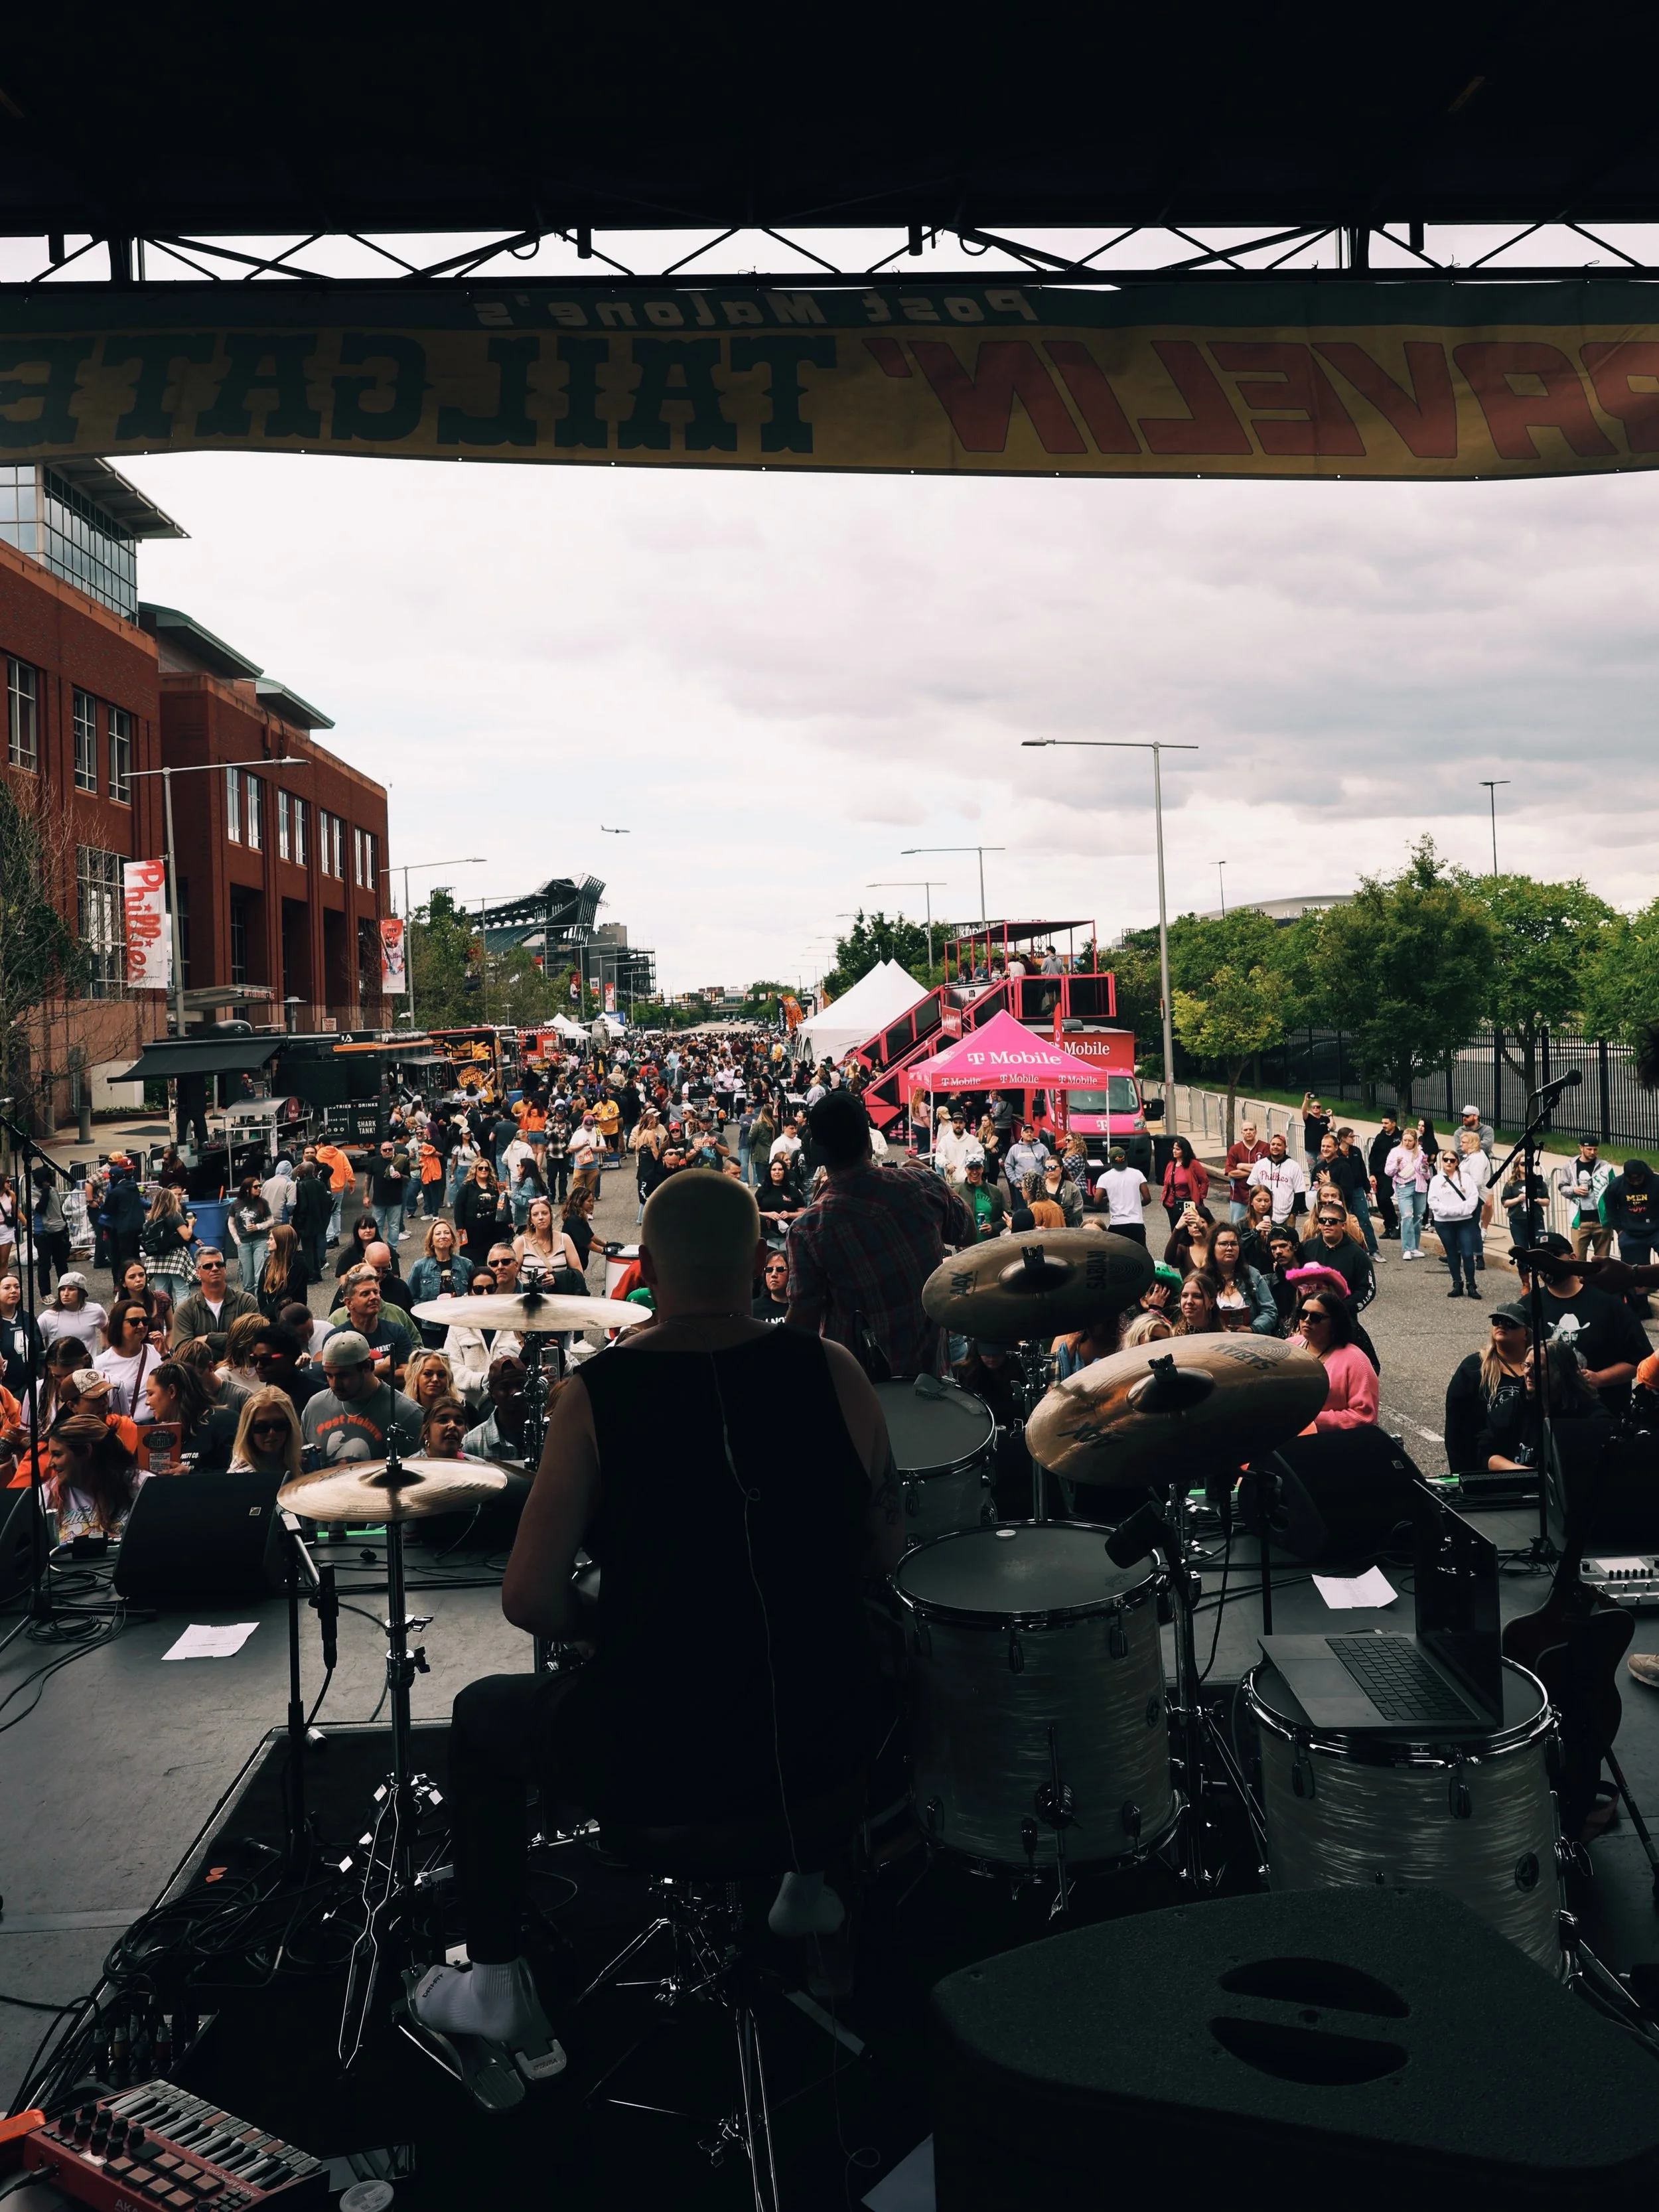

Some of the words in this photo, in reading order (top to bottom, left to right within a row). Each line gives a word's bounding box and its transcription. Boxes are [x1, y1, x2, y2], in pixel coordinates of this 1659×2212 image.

[124, 859, 165, 984] Phillies
[1063, 1041, 1110, 1056] Mobile
[988, 1051, 1061, 1065] Mobile
[950, 1076, 981, 1086] Mobile
[1009, 1074, 1039, 1084] Mobile
[1067, 1075, 1098, 1085] Mobile
[1260, 1169, 1289, 1183] Phillies
[1085, 1250, 1107, 1290] SABIAN
[1209, 1343, 1279, 1370] SABIAN
[316, 1414, 346, 1436] Post
[422, 1973, 443, 1998] DRI-FIT
[236, 2184, 261, 2197] AKAI
